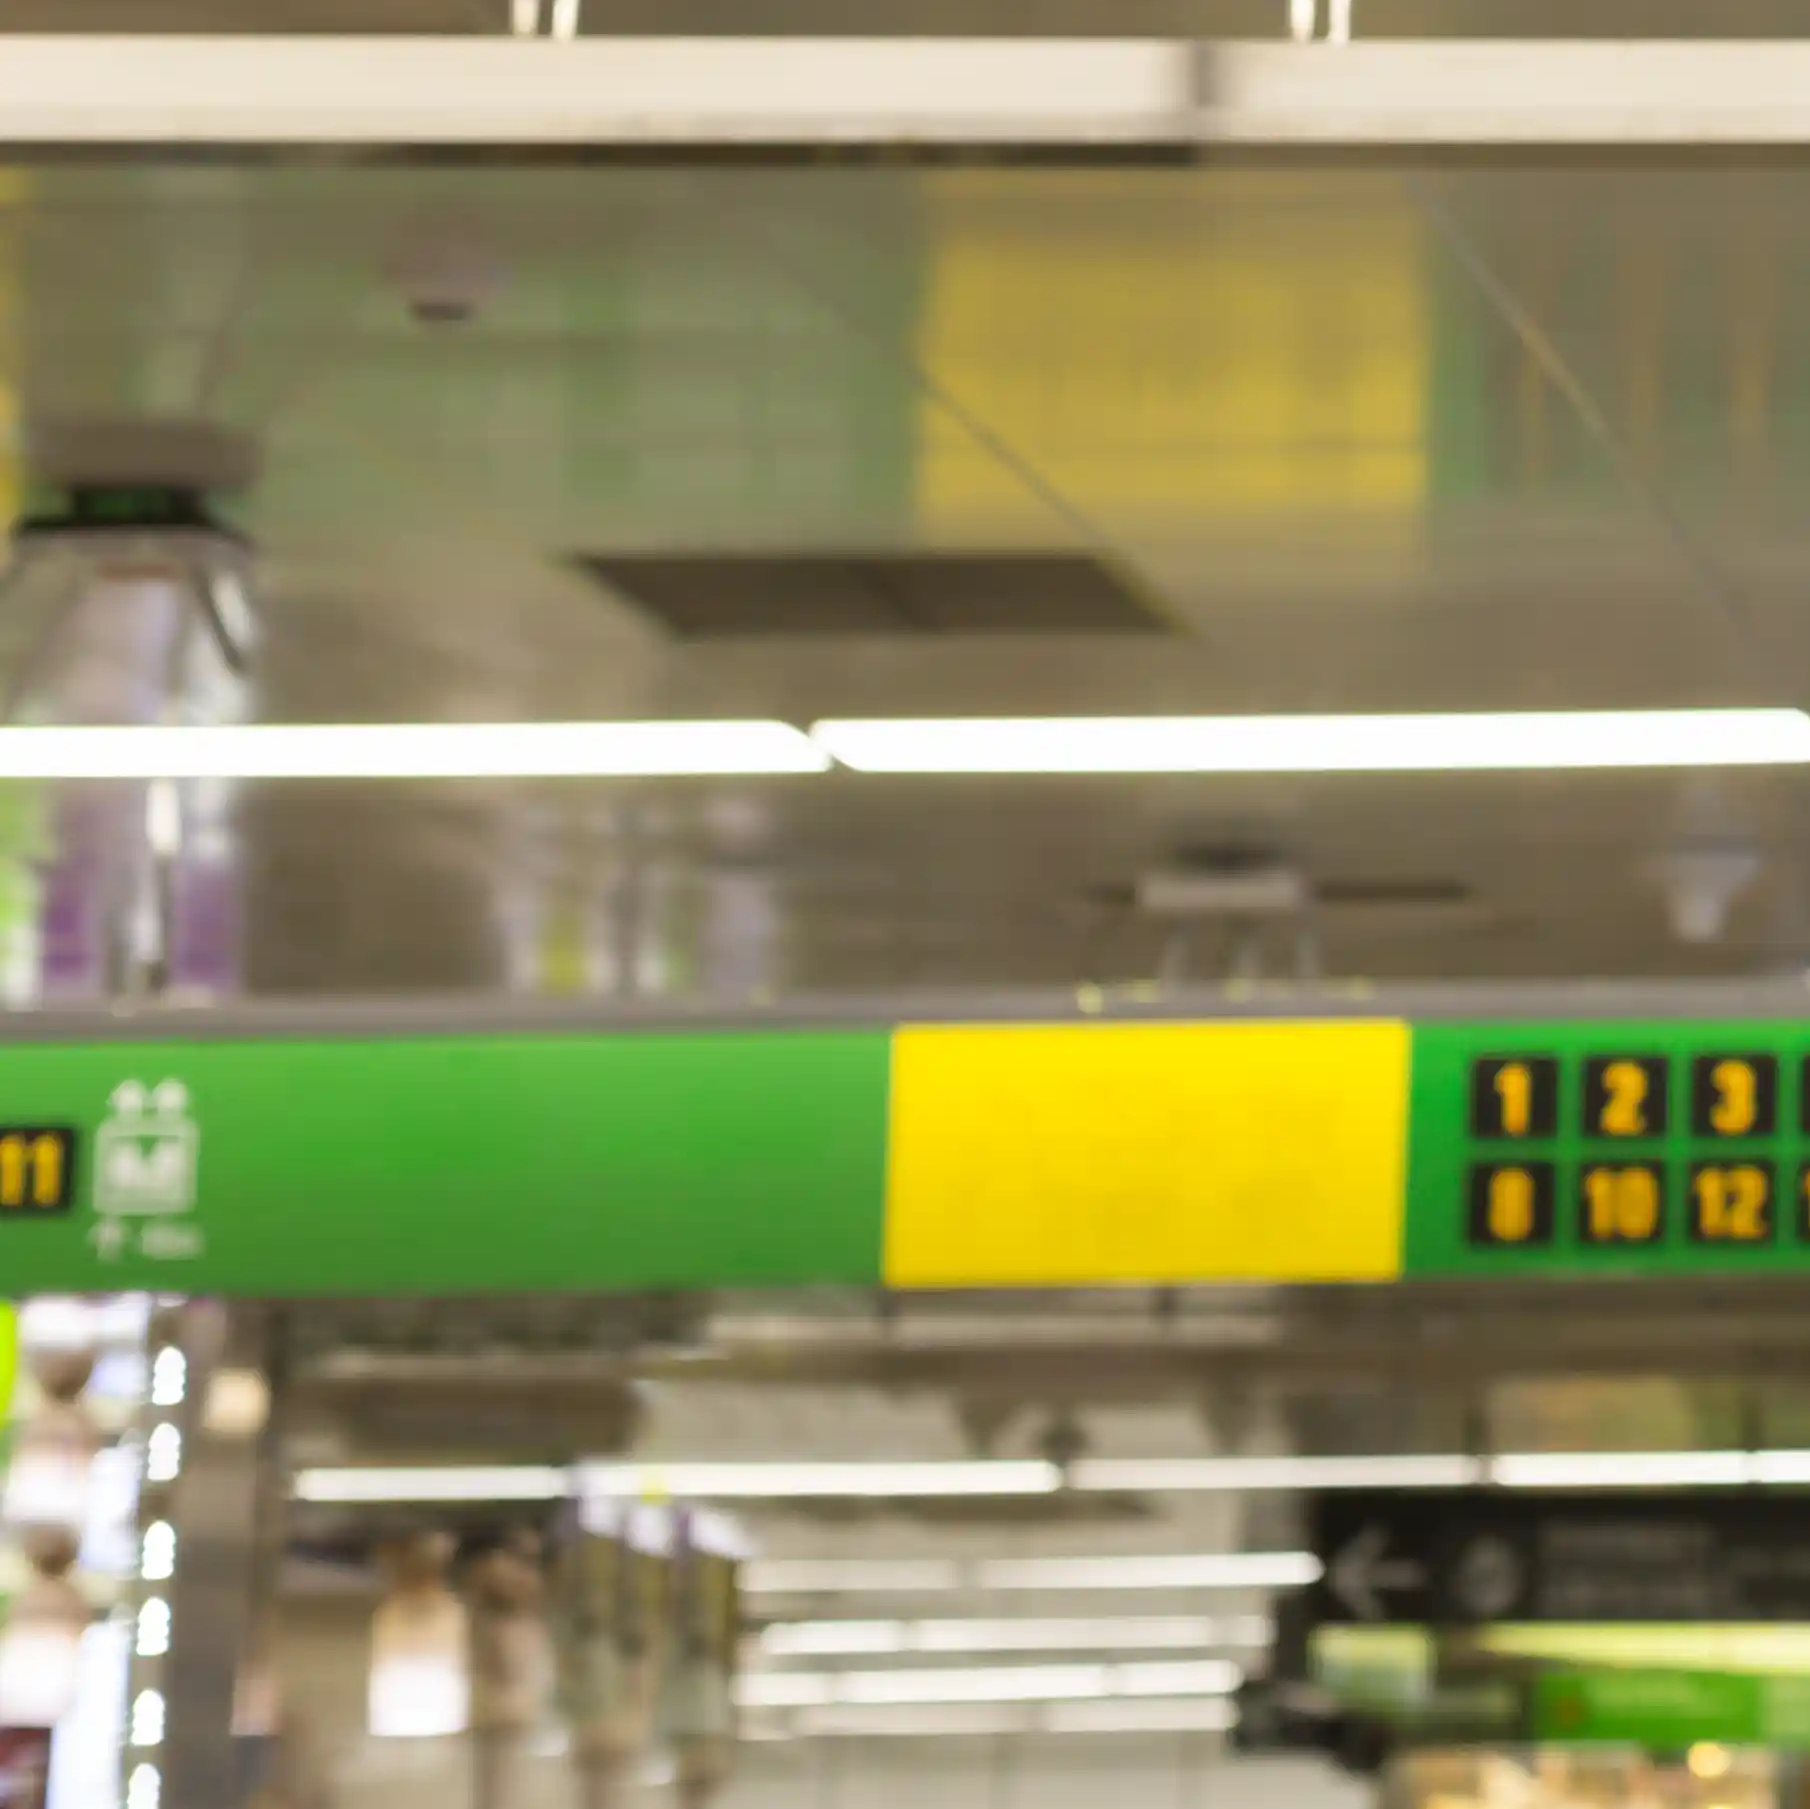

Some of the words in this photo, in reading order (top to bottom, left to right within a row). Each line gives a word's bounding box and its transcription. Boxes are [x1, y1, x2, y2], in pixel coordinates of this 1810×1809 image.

[1494, 1062, 1533, 1136] 1
[1600, 1060, 1649, 1136] 2
[1711, 1059, 1757, 1136] 3
[1692, 1166, 1768, 1239] 12
